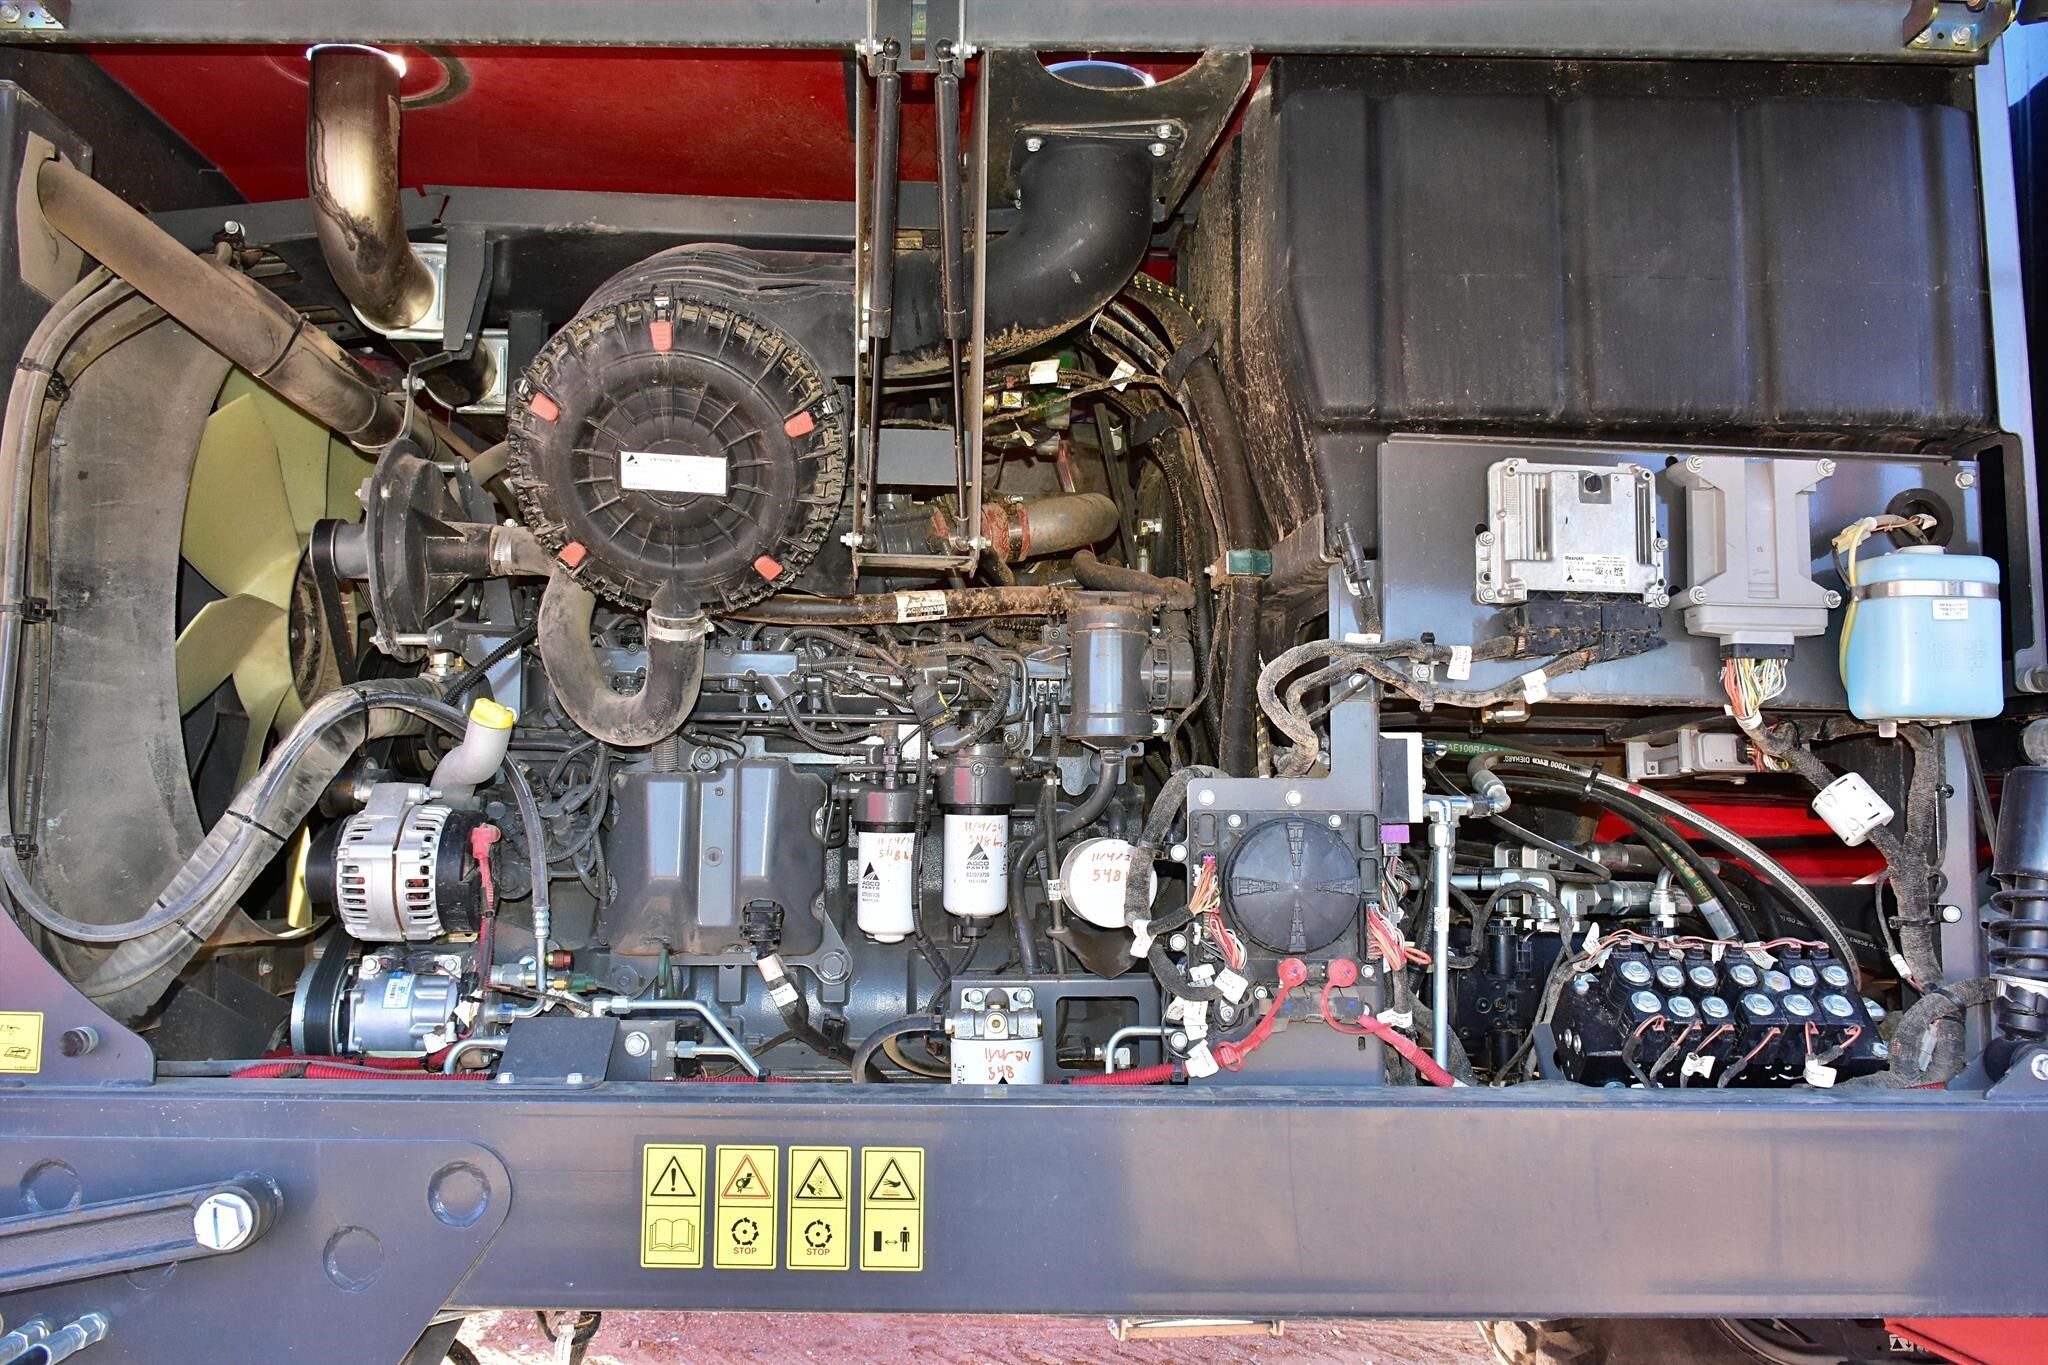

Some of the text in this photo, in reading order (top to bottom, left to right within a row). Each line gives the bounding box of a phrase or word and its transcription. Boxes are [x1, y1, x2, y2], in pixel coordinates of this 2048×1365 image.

[1092, 868, 1121, 882] 548
[988, 1064, 1014, 1080] 548
[734, 1246, 758, 1254] STOP
[806, 1248, 831, 1256] STOP
